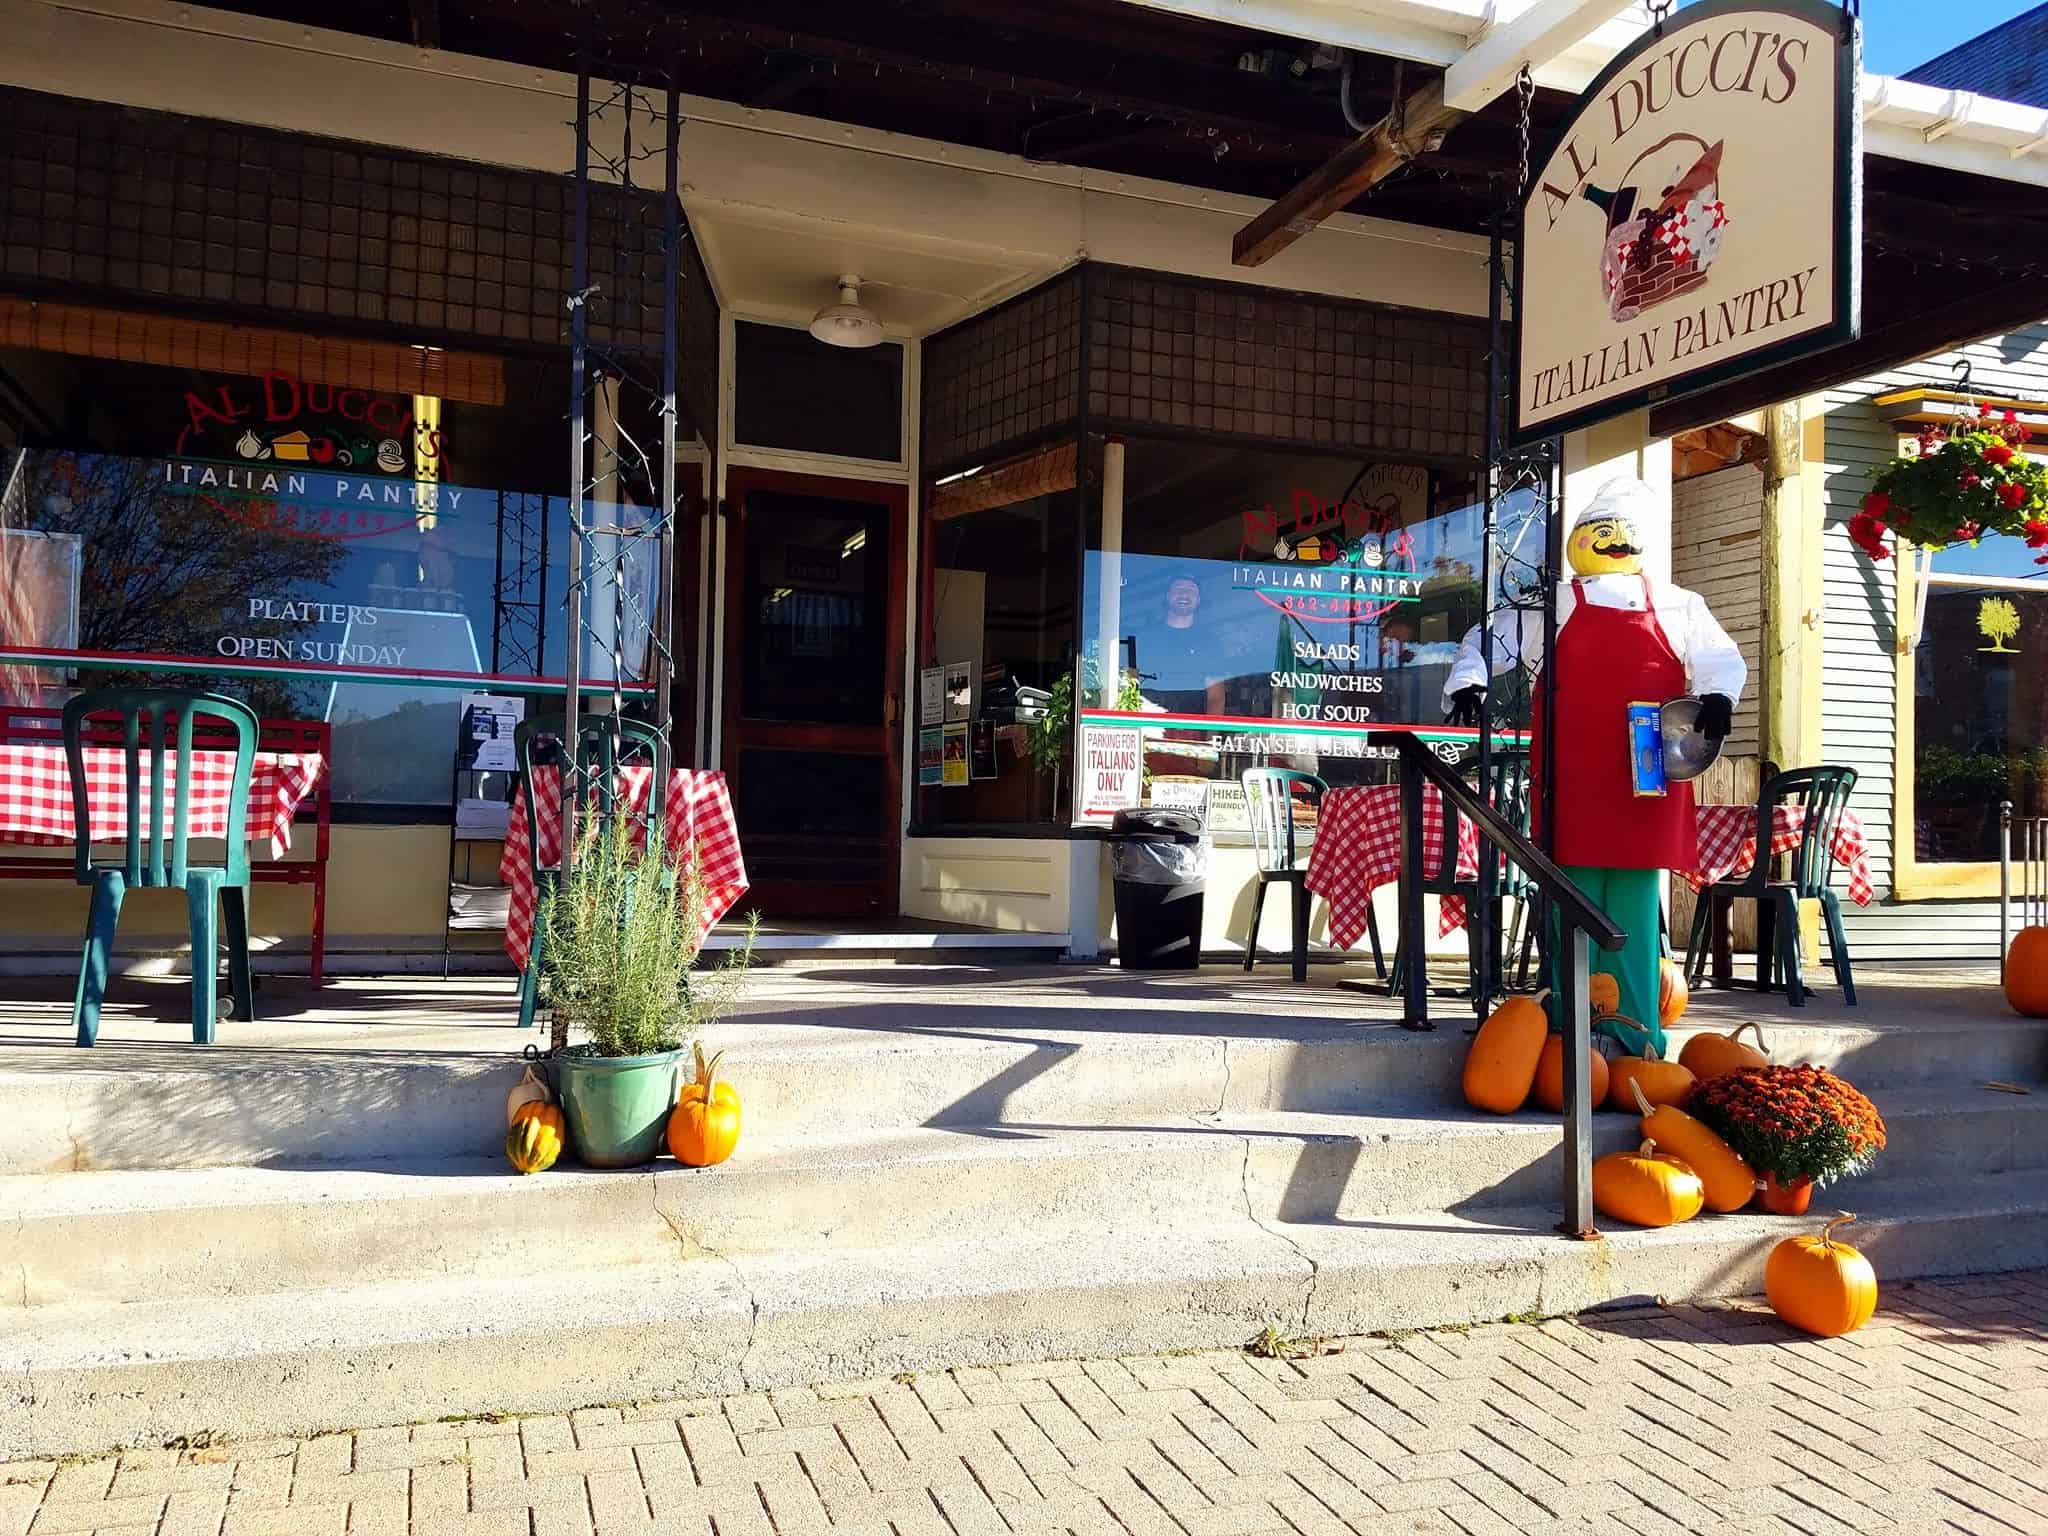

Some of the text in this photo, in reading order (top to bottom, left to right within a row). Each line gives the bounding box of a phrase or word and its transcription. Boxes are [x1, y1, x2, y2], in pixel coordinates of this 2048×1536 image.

[1541, 26, 1810, 232] AL DUCCI'S
[1529, 265, 1818, 412] ITALIAN PANTRY
[184, 384, 250, 434] AL
[165, 463, 464, 510] ITALIAN PANTRY
[1233, 567, 1424, 596] ITALIAN PANTRY
[248, 598, 378, 625] PLATTERS
[217, 636, 407, 665] OPEN SUNDAY
[1294, 641, 1360, 661] SALADS
[1270, 671, 1383, 693] SANDWICHES
[1281, 702, 1370, 723] HOT SOUP
[1087, 733, 1137, 750] PARKING FOR
[1211, 735, 1243, 753] EAT
[1246, 737, 1271, 754] IN
[1087, 749, 1136, 770] ITALIANS
[1097, 772, 1126, 792] ONLY
[1212, 789, 1245, 800] HIKER
[1211, 801, 1246, 810] FRIENDLY
